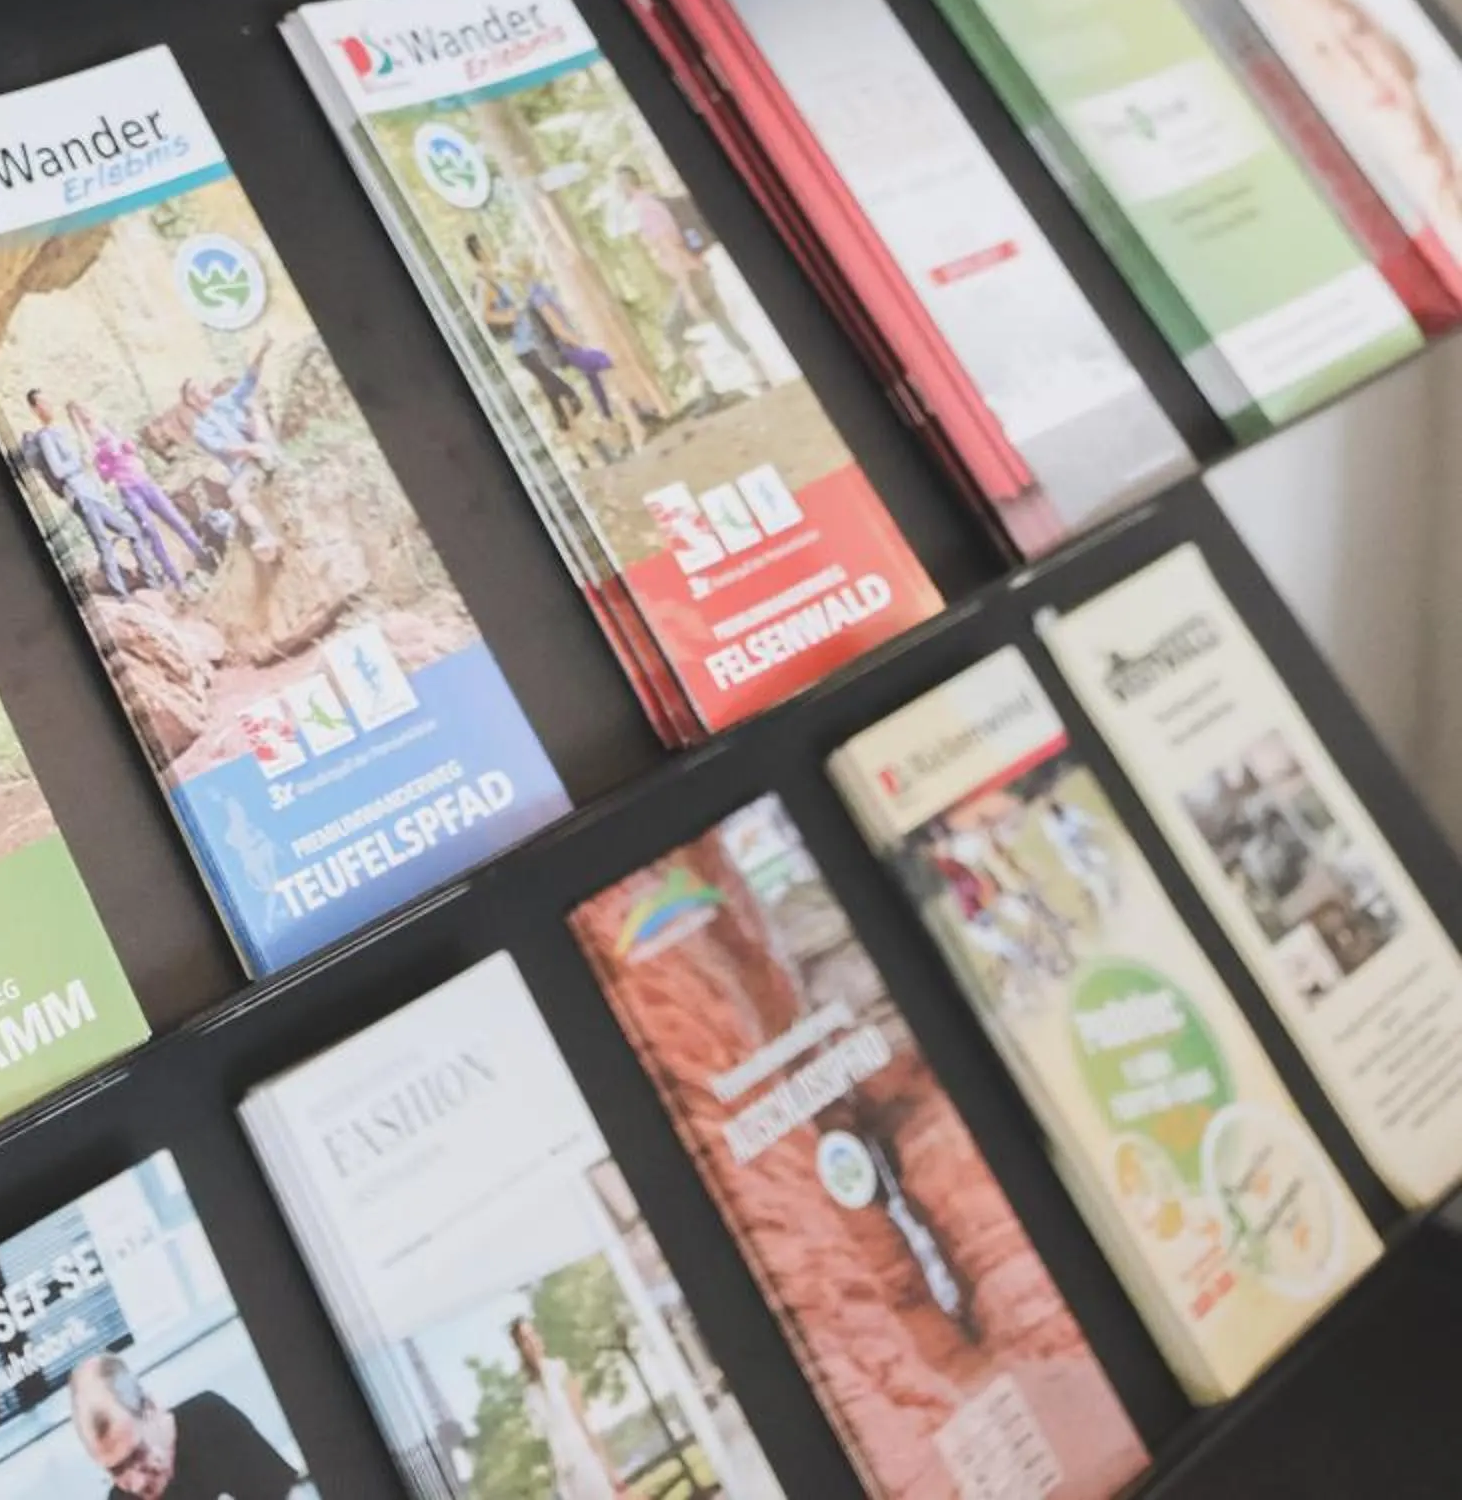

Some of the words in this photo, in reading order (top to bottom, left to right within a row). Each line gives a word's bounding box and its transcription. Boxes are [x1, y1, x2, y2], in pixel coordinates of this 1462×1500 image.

[398, 3, 548, 65] Wander
[63, 134, 191, 205] Erlebnis
[704, 572, 892, 693] FELSENWALD
[274, 770, 515, 919] TEUFELSPFAD
